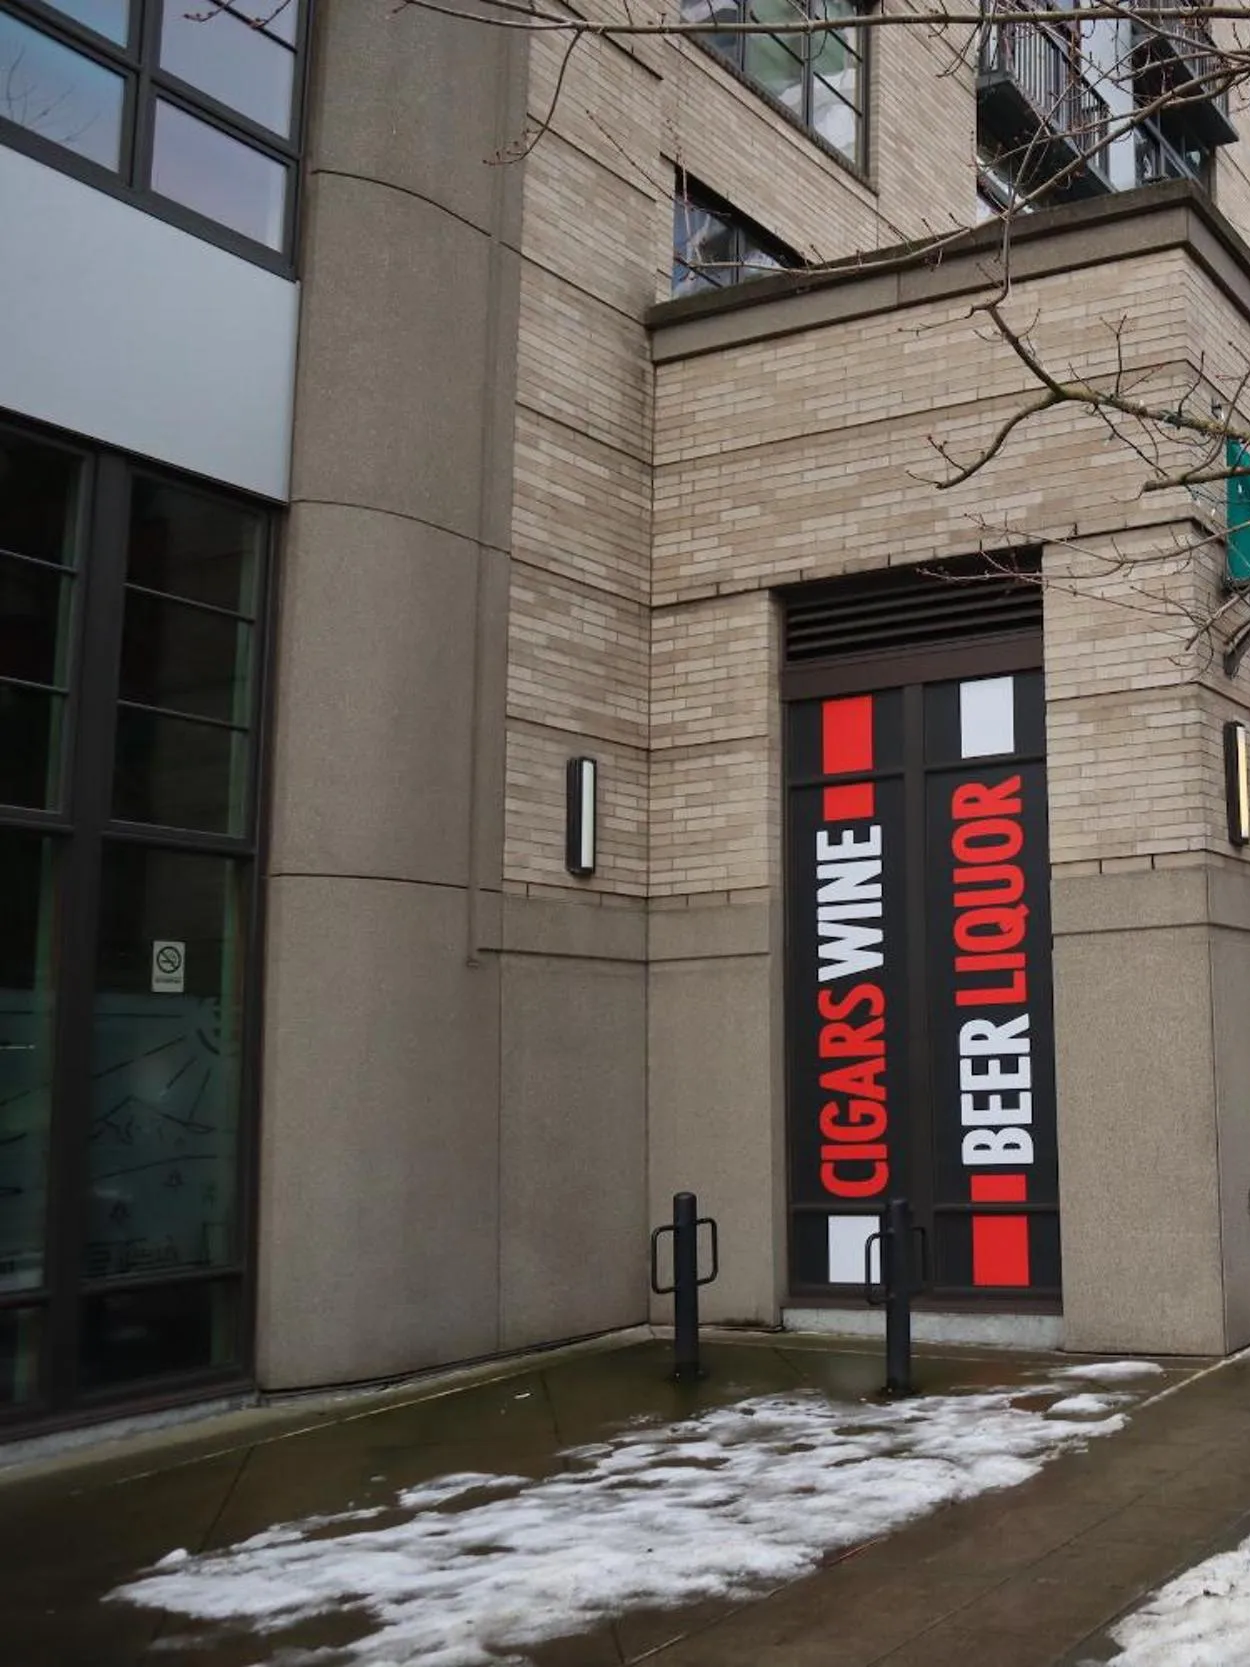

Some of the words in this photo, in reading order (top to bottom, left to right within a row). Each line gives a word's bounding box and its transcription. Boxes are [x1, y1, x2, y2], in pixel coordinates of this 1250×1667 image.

[816, 824, 883, 982] WINE
[952, 775, 1029, 1006] LIQUOR
[818, 982, 889, 1198] CIGARS
[958, 1013, 1034, 1165] BEER
